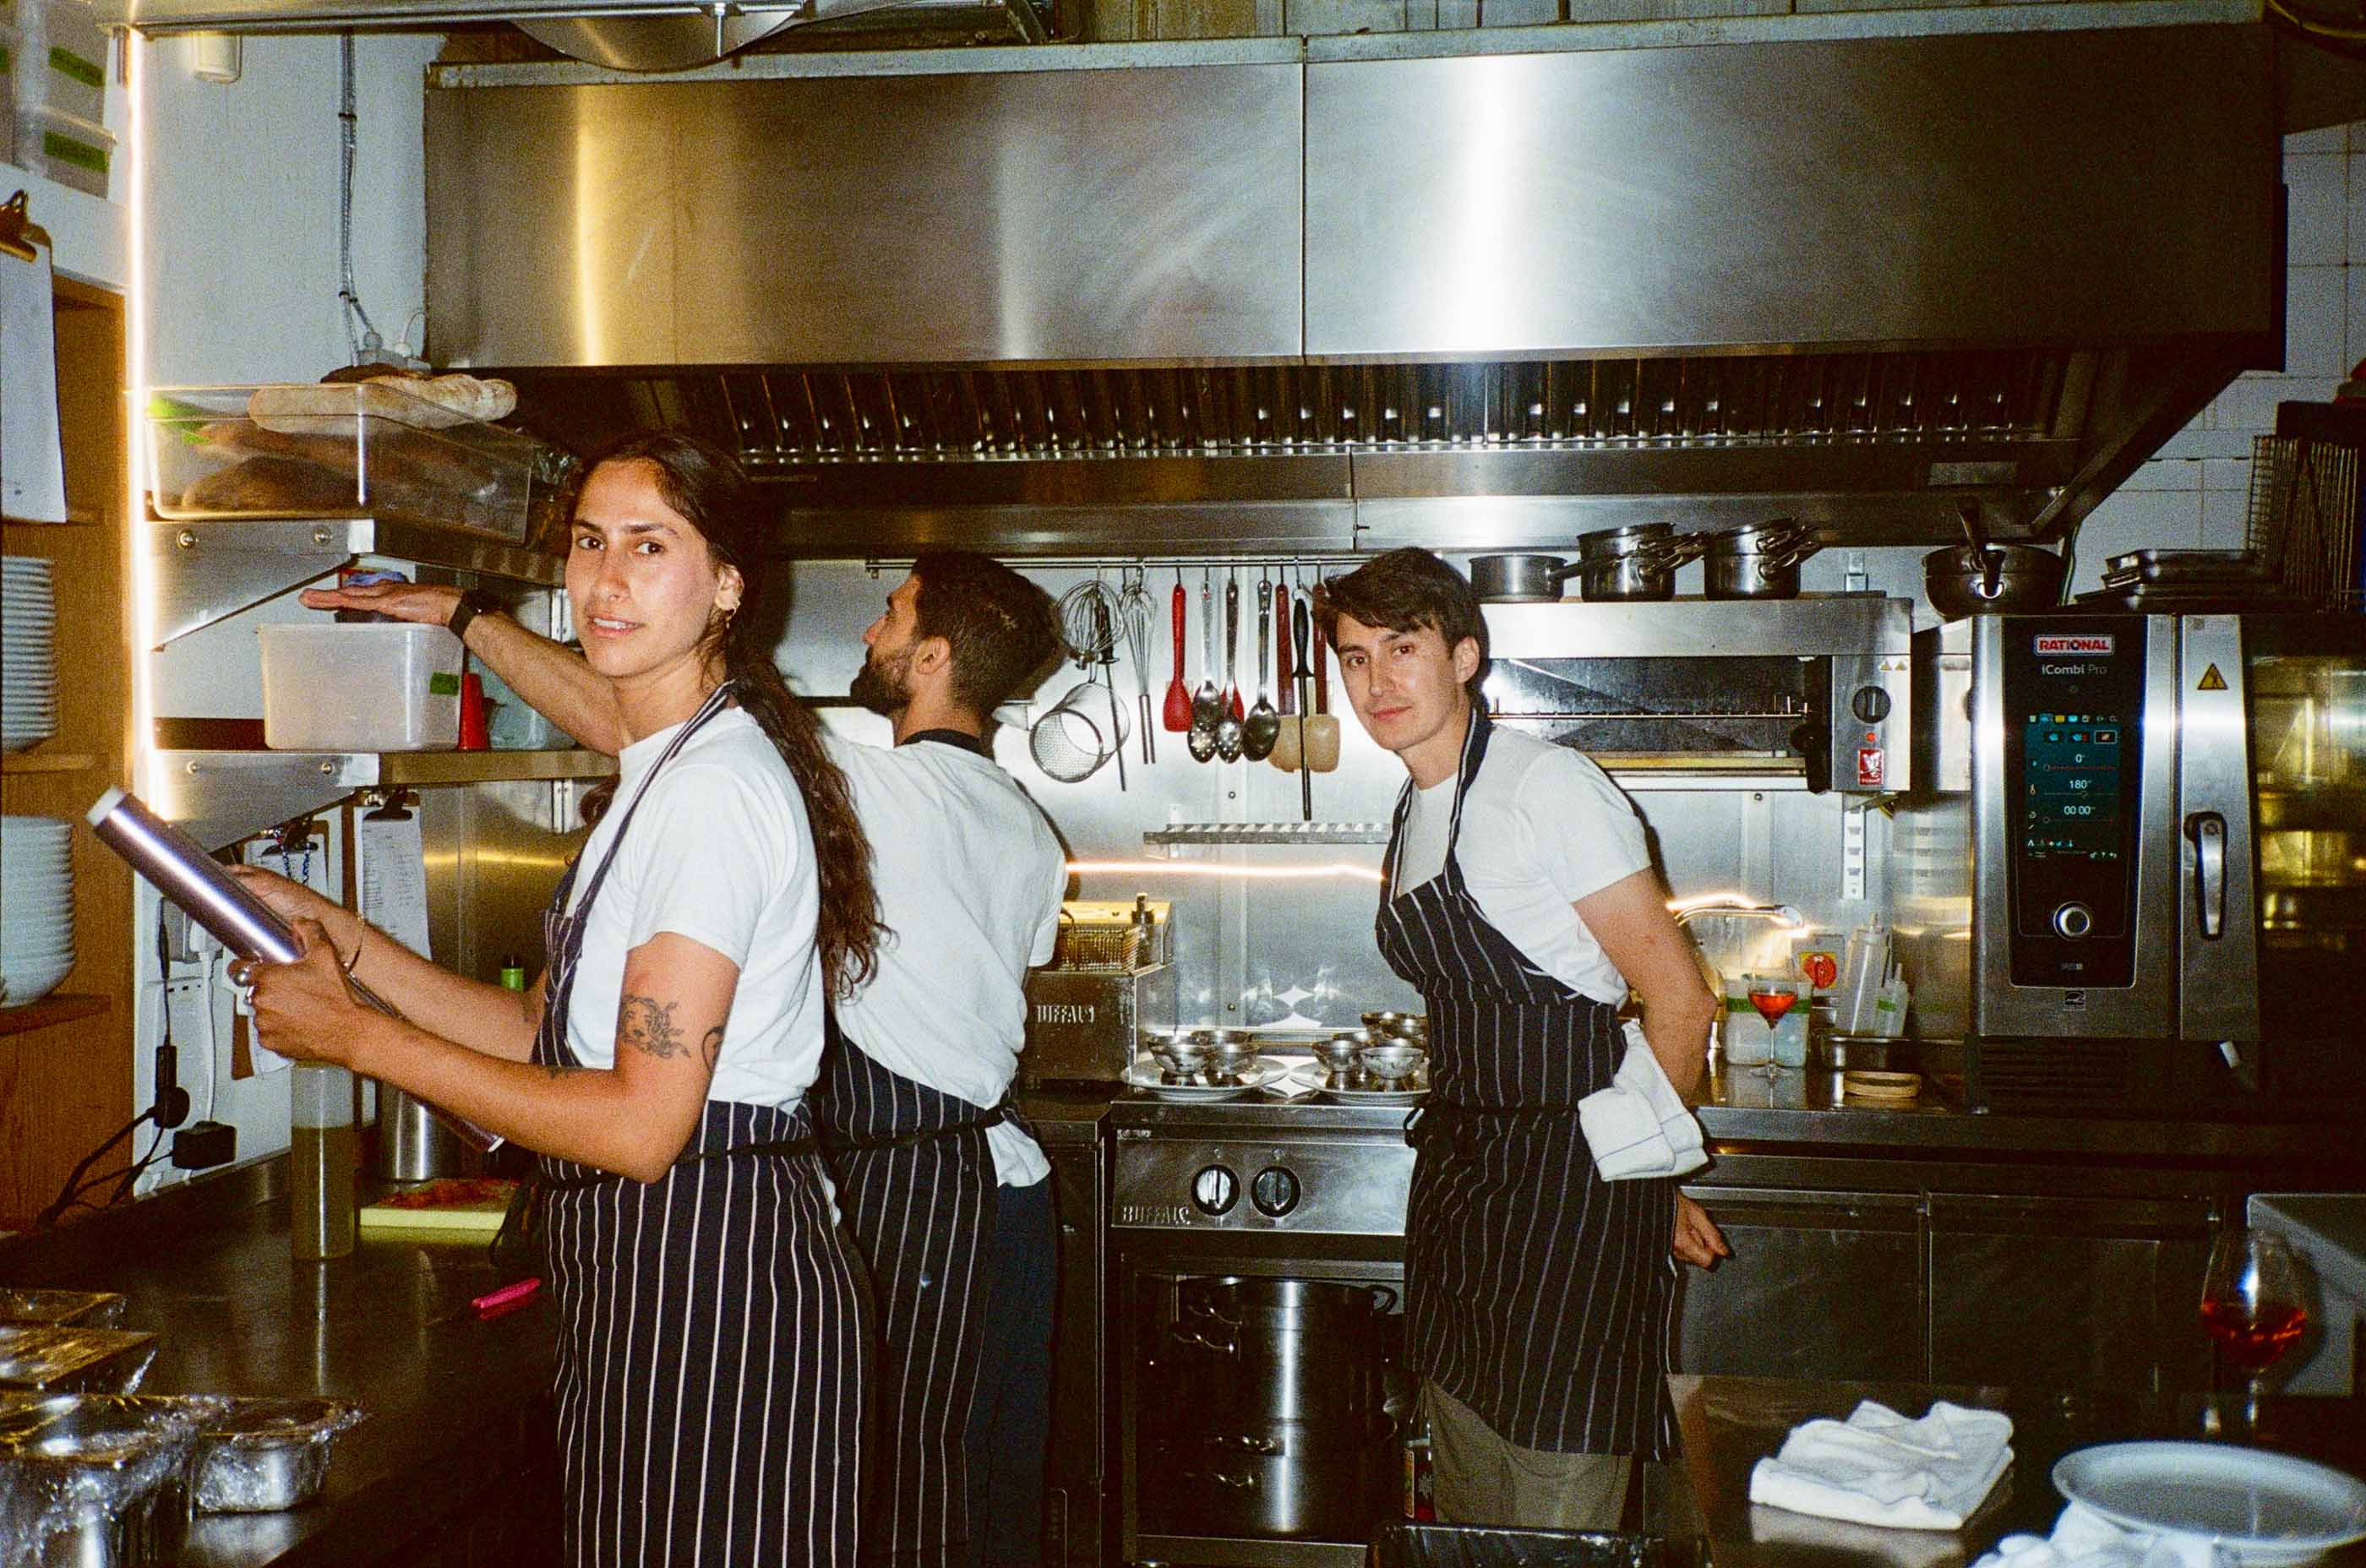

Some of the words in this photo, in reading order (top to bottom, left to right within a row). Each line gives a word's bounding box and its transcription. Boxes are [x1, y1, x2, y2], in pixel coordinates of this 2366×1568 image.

[2038, 639, 2110, 651] RATIONAL
[2041, 663, 2085, 675] iCombi
[2088, 663, 2108, 675] Pro
